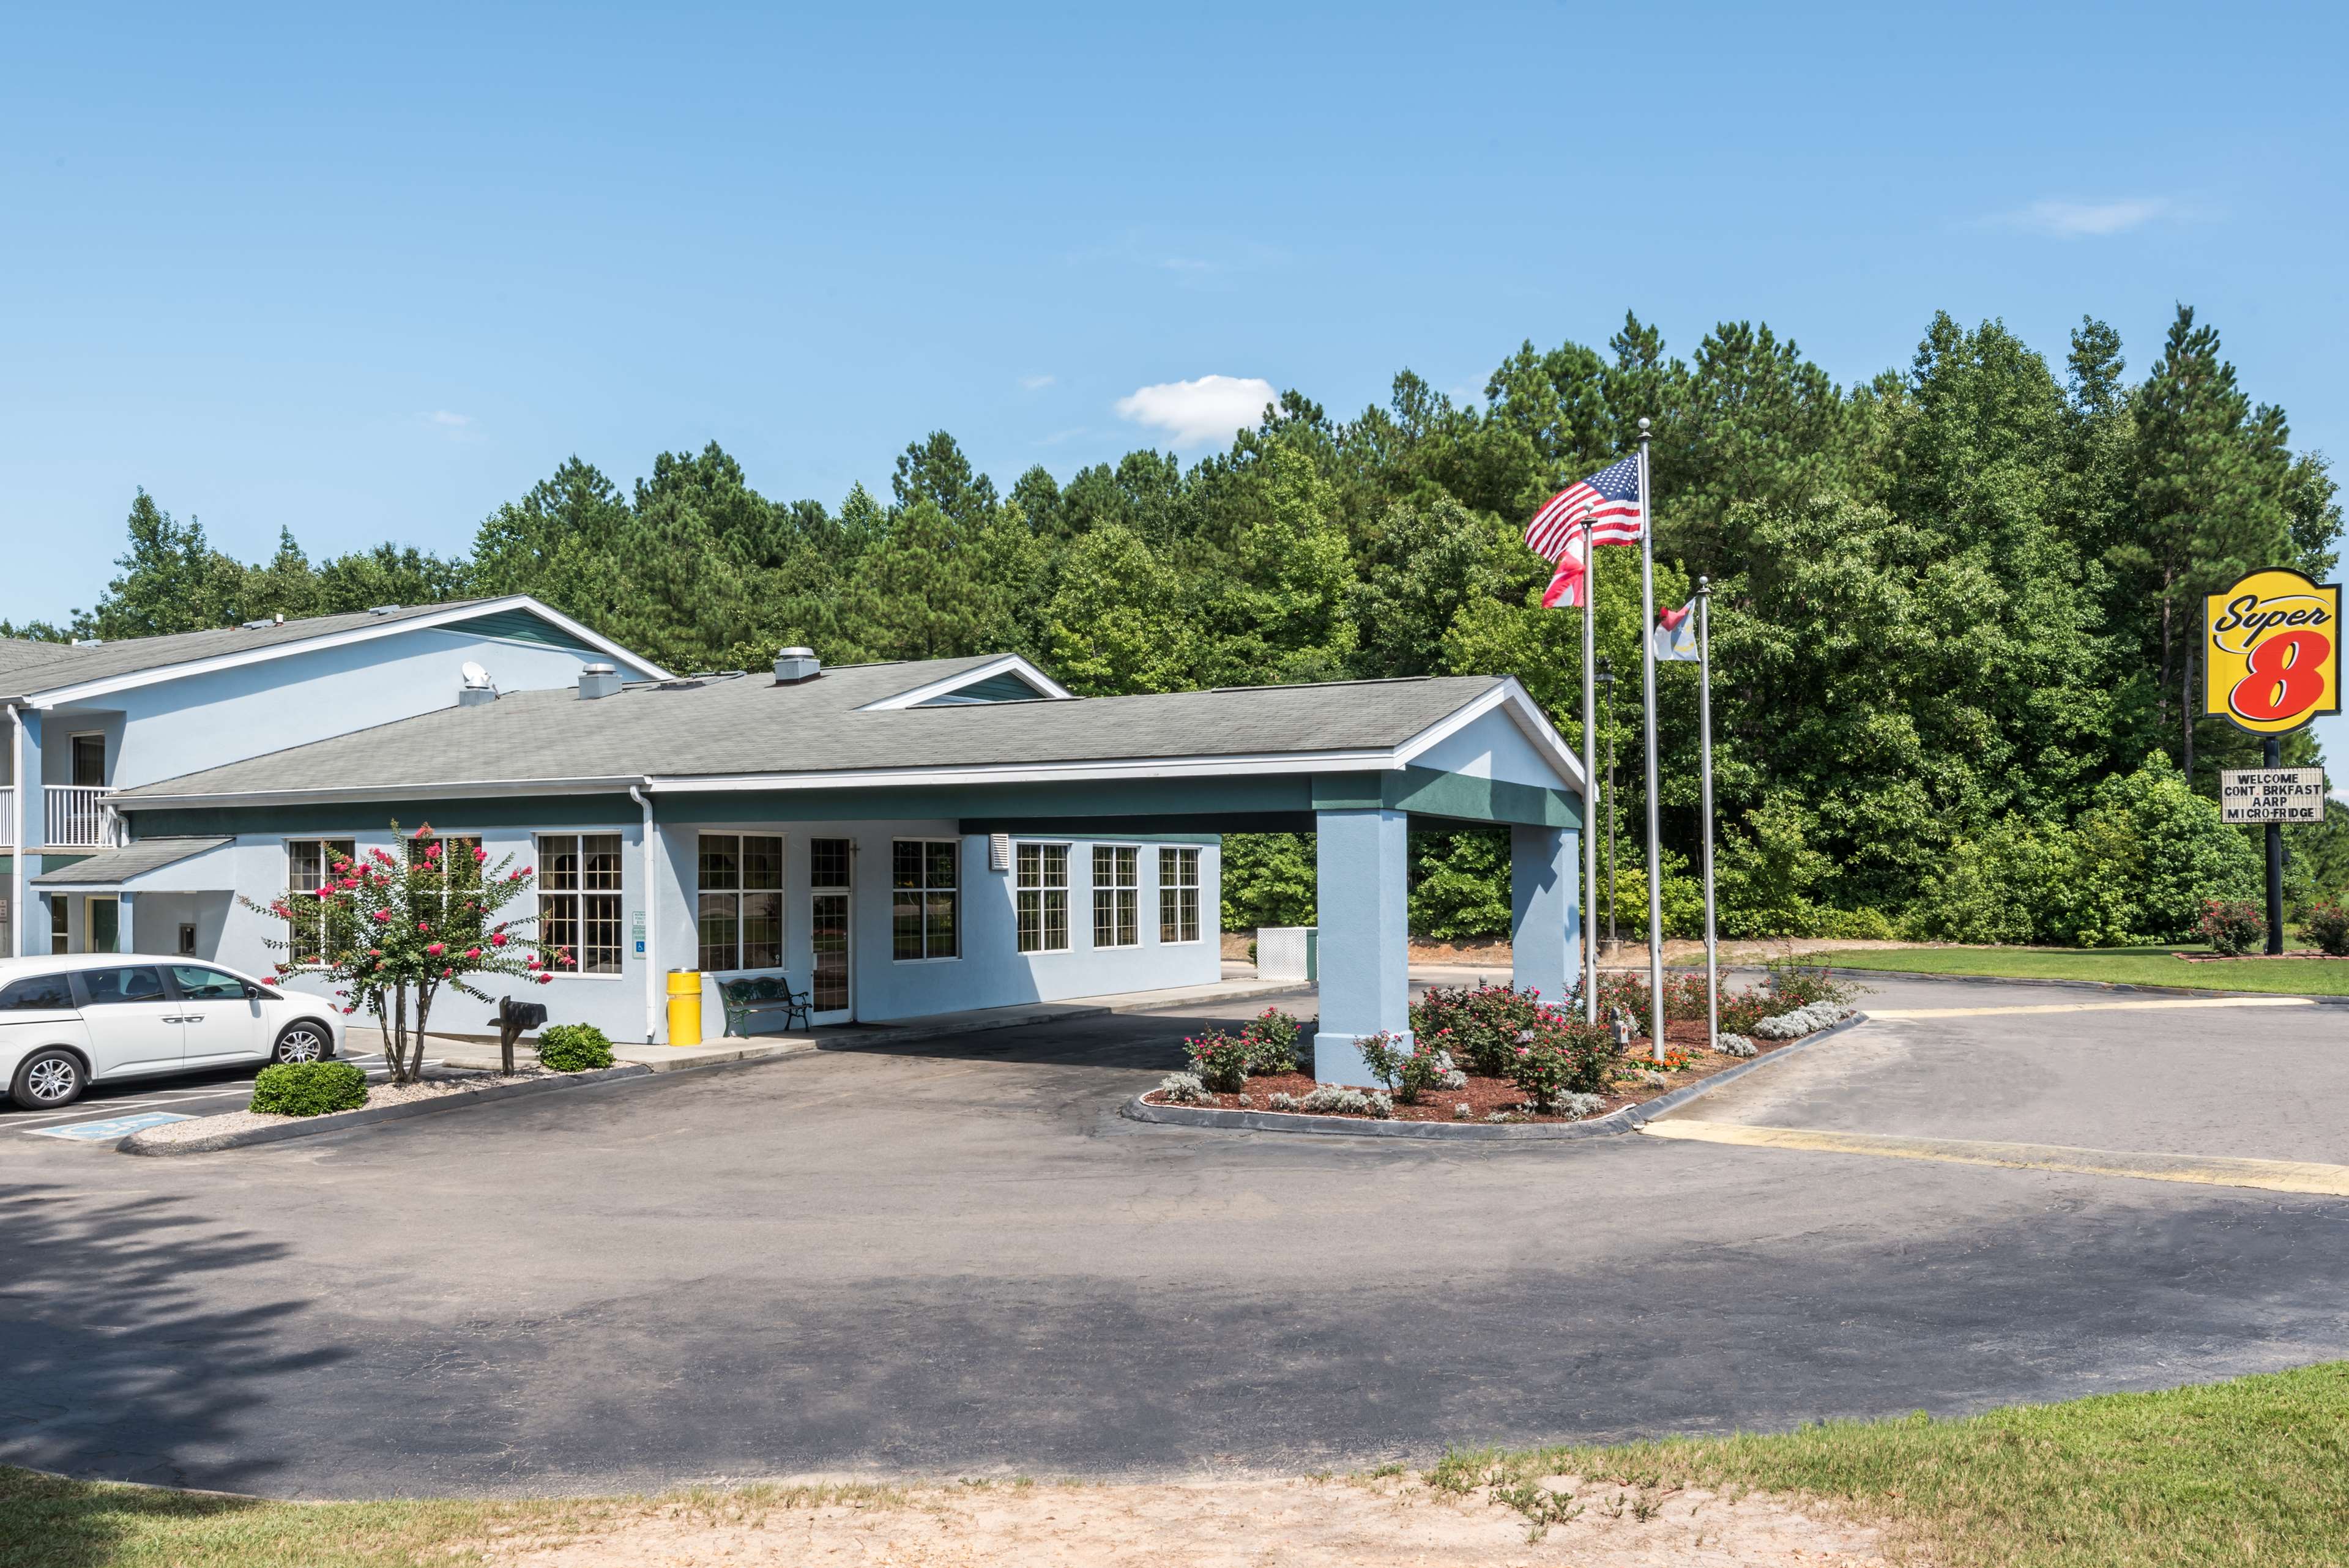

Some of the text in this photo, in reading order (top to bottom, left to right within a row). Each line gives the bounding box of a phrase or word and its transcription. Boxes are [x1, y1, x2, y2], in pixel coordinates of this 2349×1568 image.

[2213, 594, 2332, 648] Super
[2228, 630, 2331, 722] 8
[2238, 773, 2298, 784] WELCOME
[2224, 784, 2321, 796] CONT. BRKFAST
[2252, 797, 2287, 807] AARP
[2227, 808, 2314, 819] MICRO-FRIDGE
